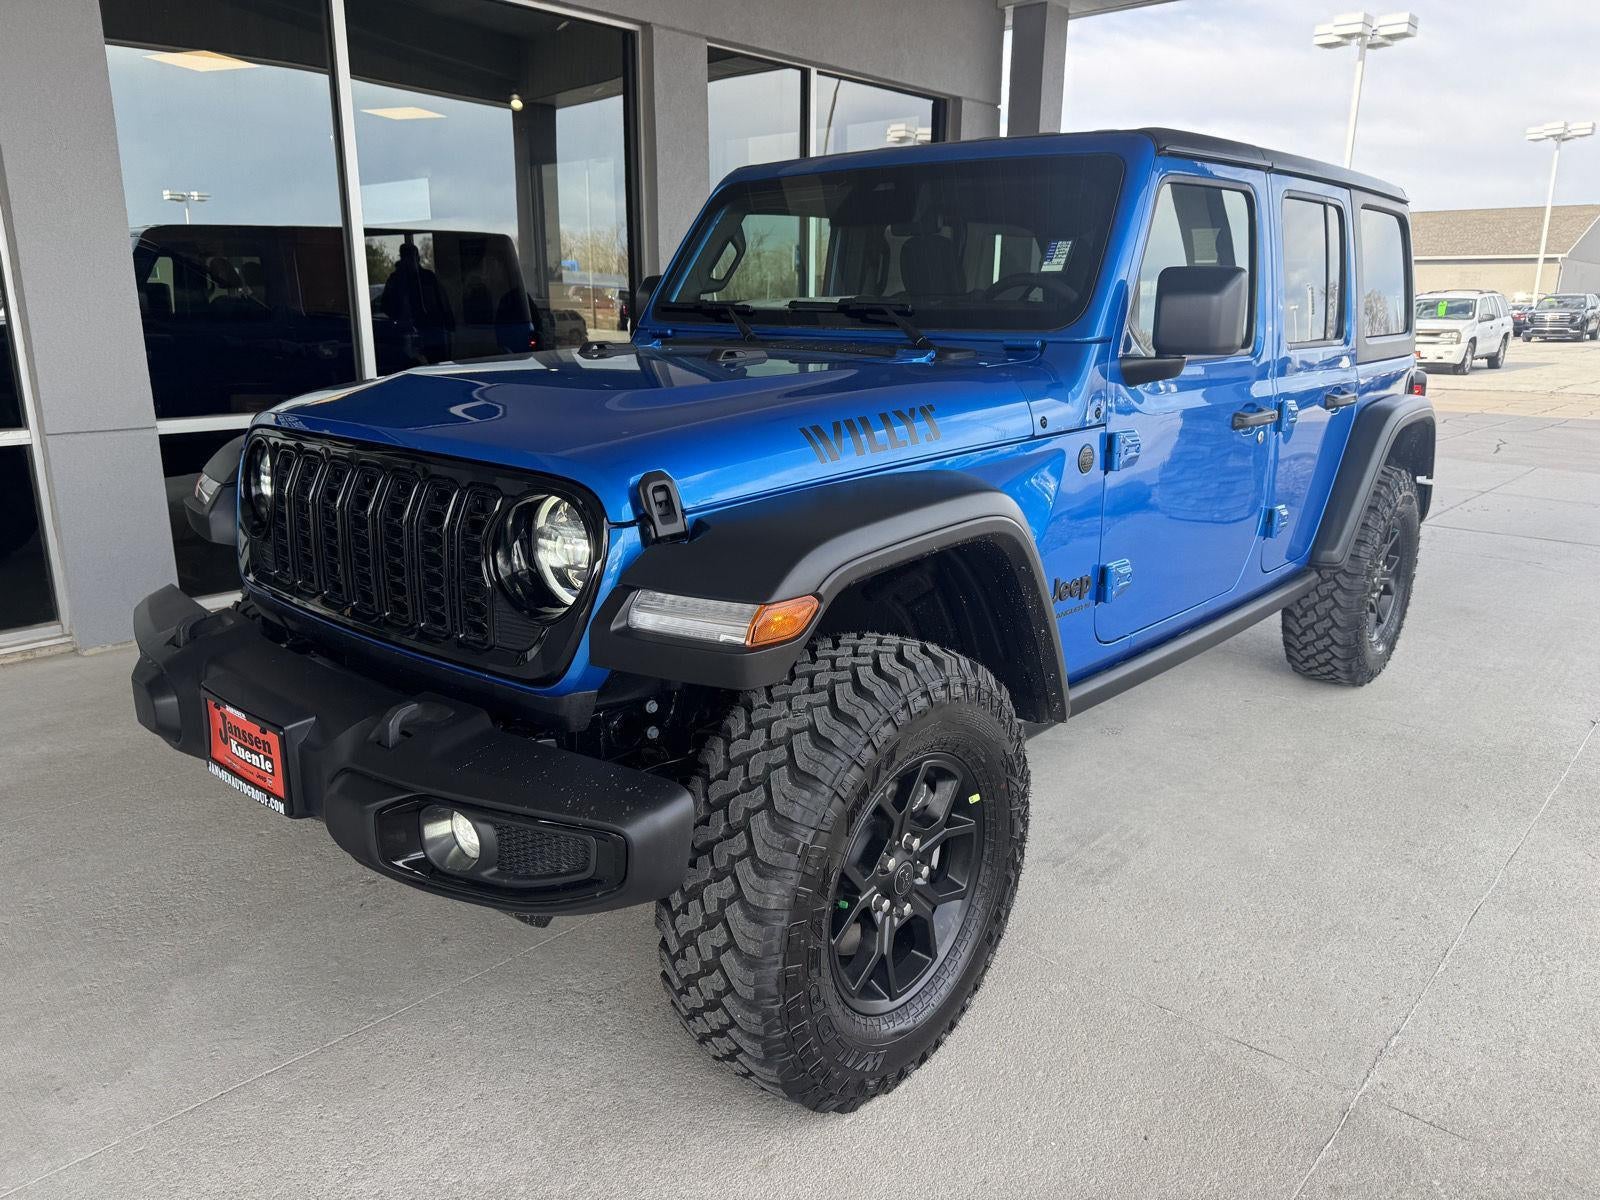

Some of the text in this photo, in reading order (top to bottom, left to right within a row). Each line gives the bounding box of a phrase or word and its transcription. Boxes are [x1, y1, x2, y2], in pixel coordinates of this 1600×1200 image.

[799, 404, 941, 464] WILLYS
[1052, 575, 1092, 604] Jeep
[219, 711, 273, 755] Janssen
[230, 738, 273, 774] Kuenle
